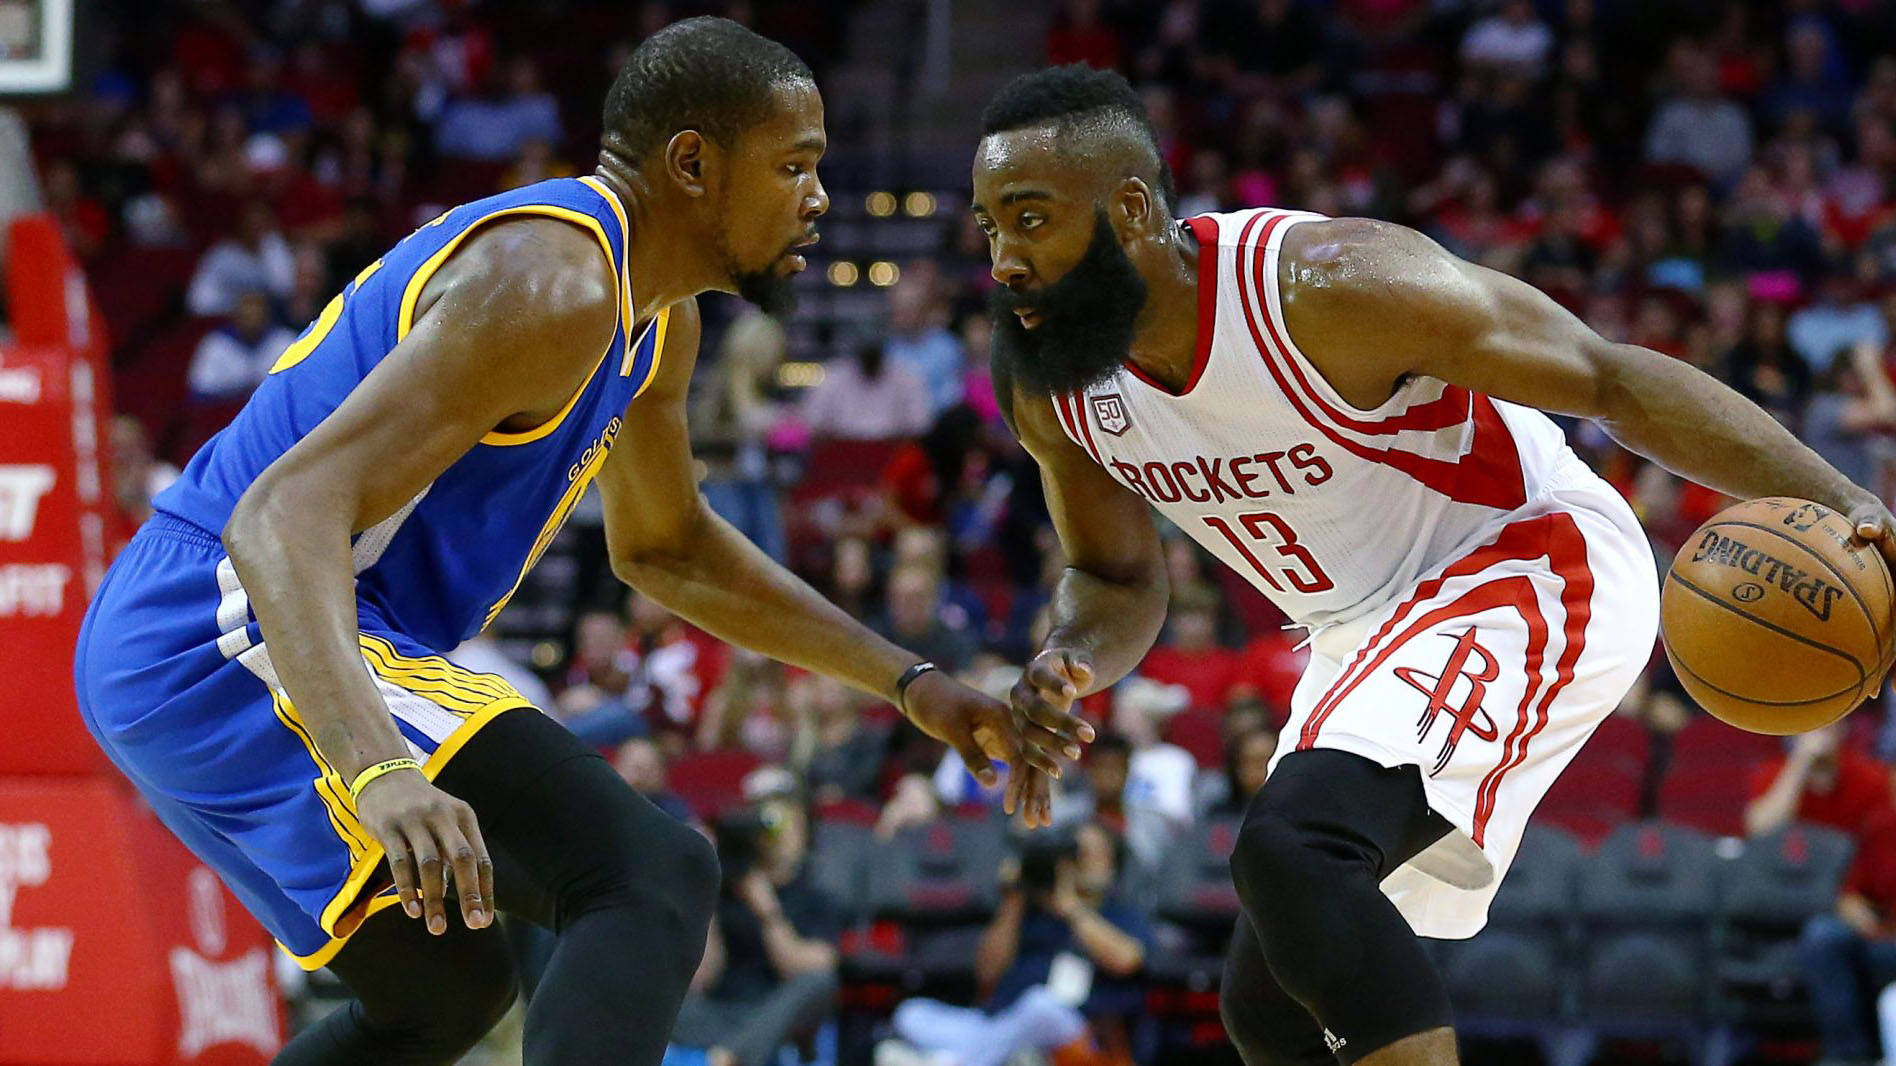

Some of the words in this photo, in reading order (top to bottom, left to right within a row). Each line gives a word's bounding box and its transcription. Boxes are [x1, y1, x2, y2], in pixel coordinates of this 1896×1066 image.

[1096, 400, 1120, 420] 50
[1109, 443, 1333, 504] ROCKETS
[1202, 512, 1335, 593] 13
[1692, 530, 1844, 622] SPALDING
